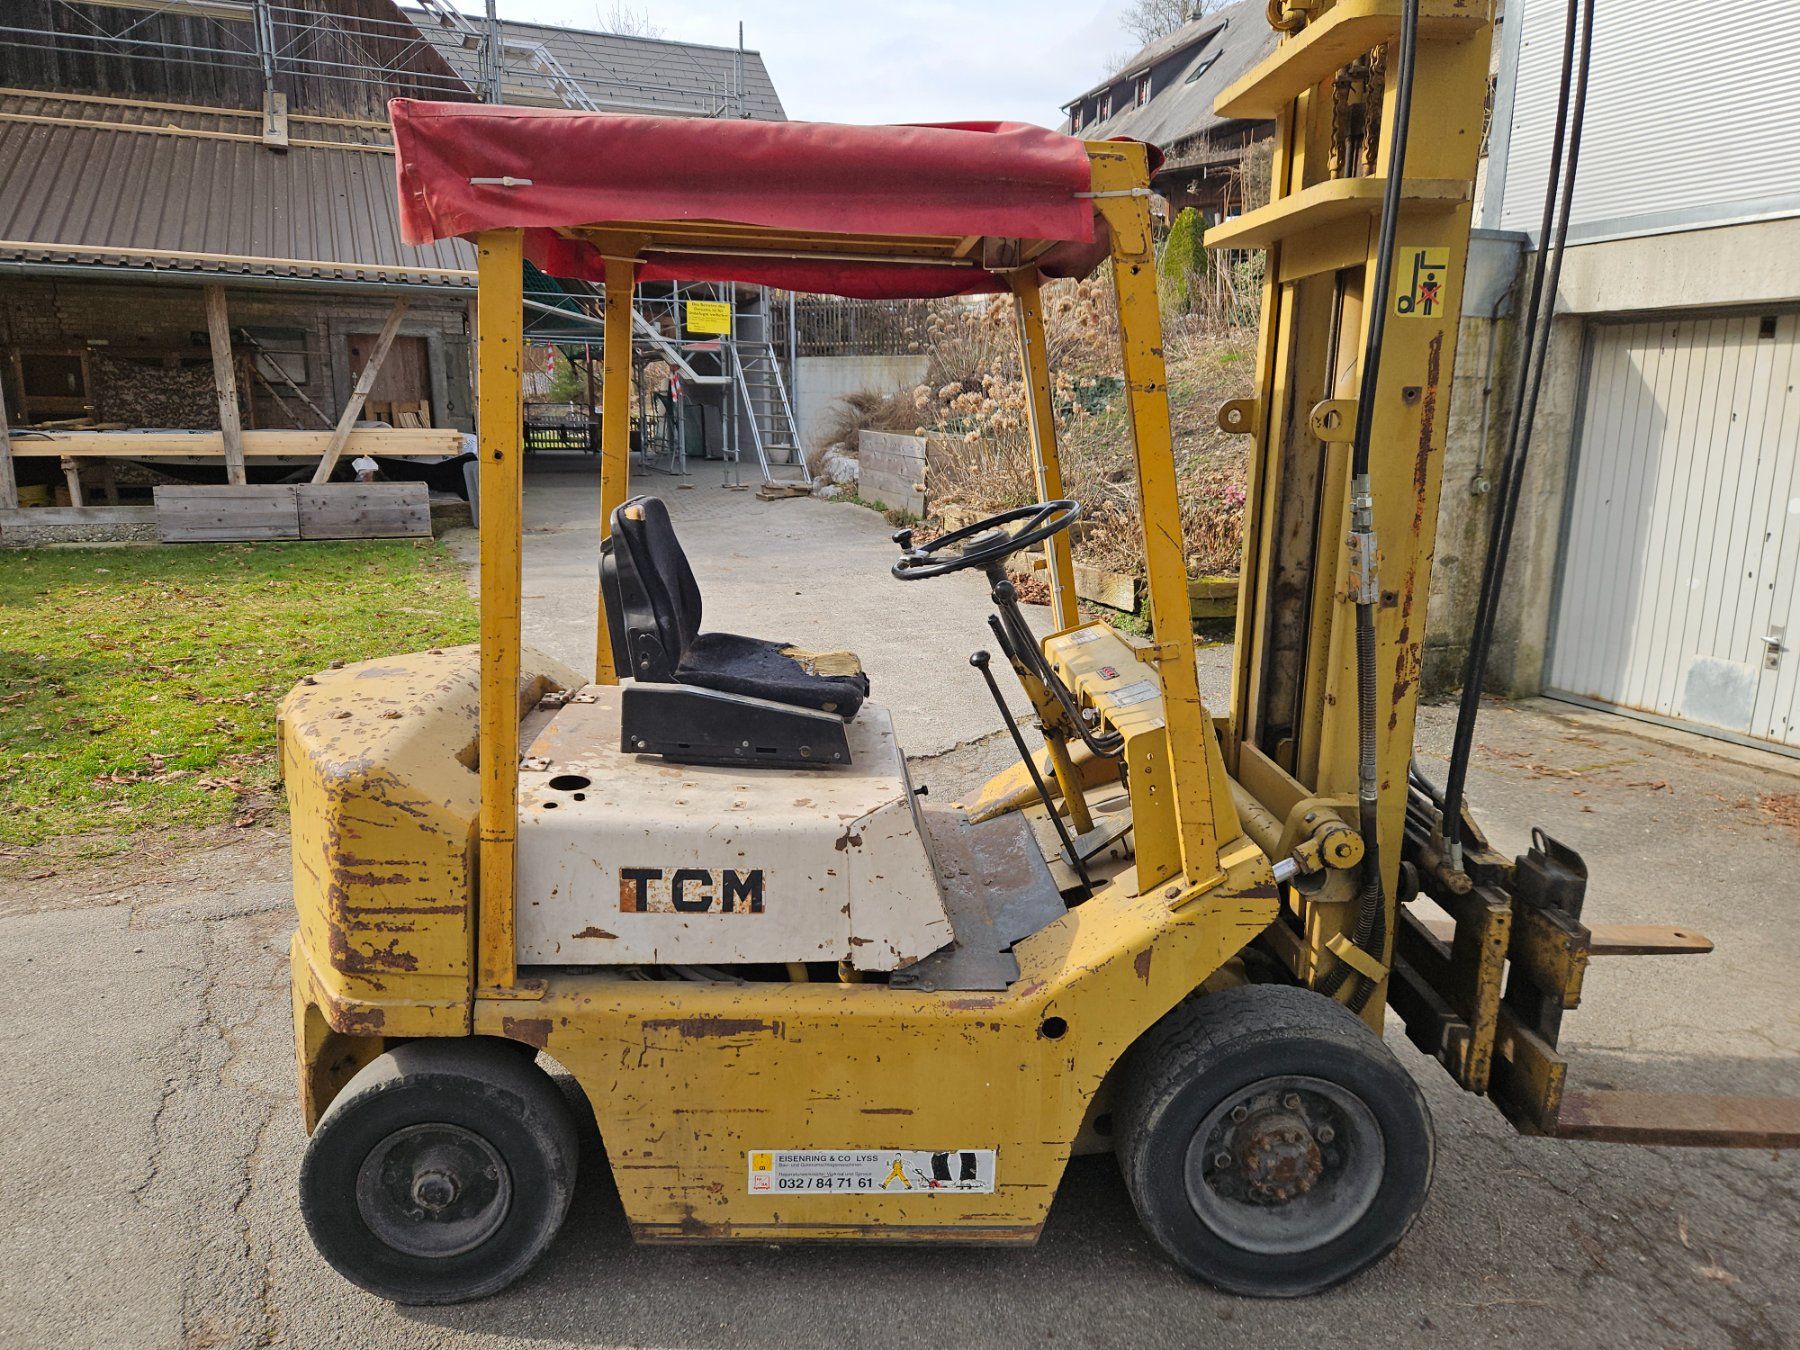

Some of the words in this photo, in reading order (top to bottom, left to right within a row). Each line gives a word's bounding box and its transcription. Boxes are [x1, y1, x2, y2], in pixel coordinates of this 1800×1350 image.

[622, 868, 763, 912] TCM
[779, 1178, 804, 1189] 032
[806, 1178, 812, 1188] /
[816, 1178, 832, 1188] 84
[837, 1178, 852, 1188] 71
[858, 1177, 873, 1188] 61
